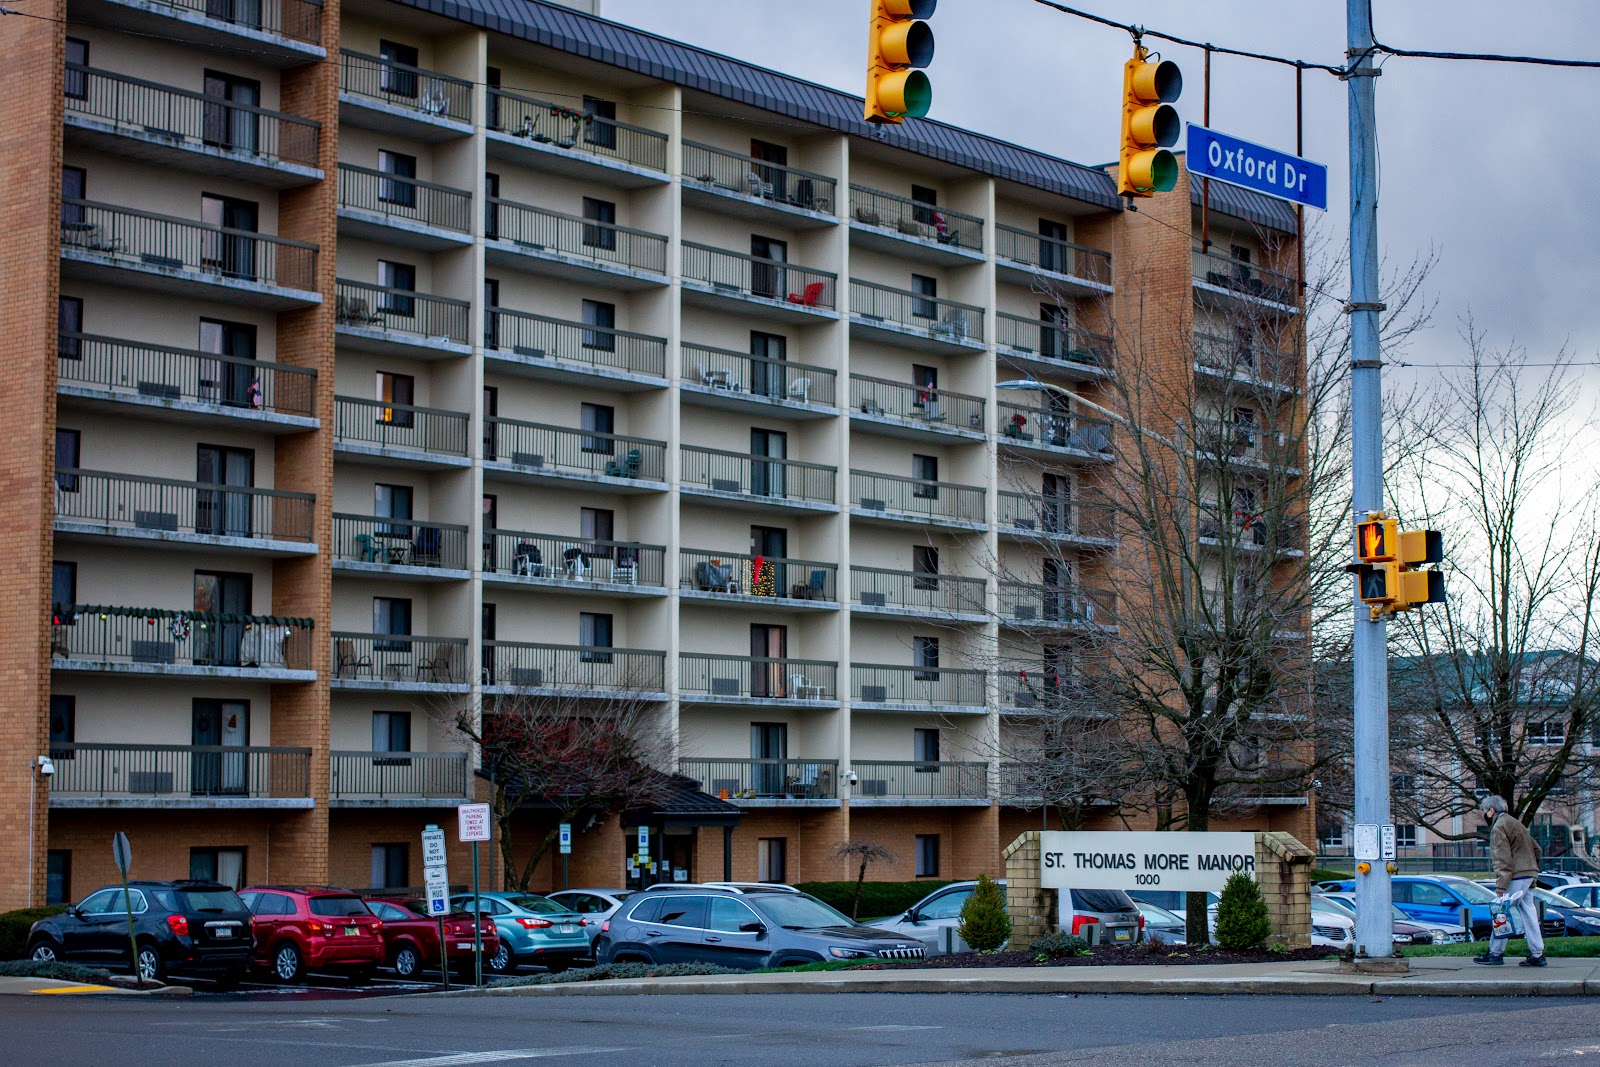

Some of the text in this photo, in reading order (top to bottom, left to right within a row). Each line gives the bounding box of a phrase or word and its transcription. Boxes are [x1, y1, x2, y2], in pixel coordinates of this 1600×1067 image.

[1208, 140, 1307, 192] Oxford Dr
[1045, 852, 1255, 871] ST. THOMAS MORE MANOR
[1135, 874, 1160, 885] 1000
[432, 890, 443, 898] HUD
